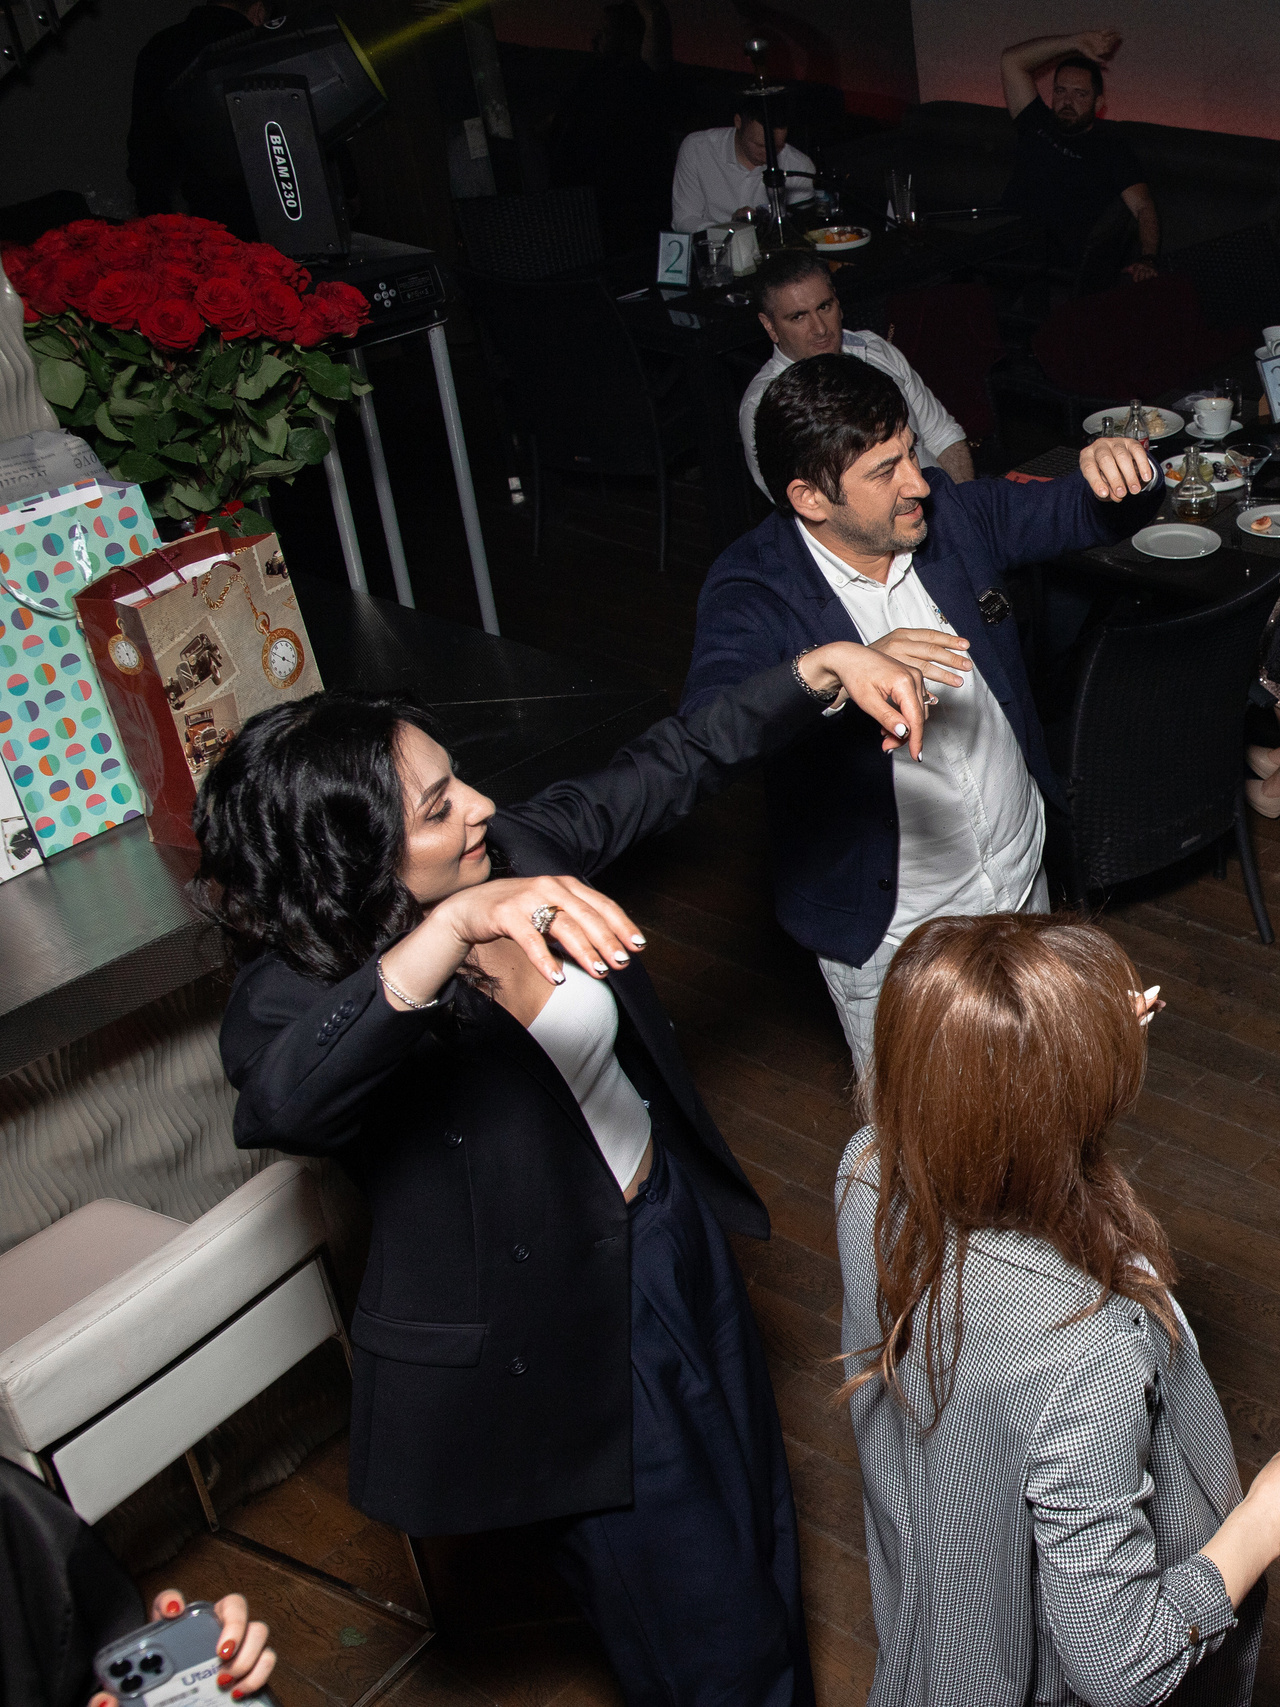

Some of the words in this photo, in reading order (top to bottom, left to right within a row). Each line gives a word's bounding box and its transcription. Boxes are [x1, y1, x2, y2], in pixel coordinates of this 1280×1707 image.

[269, 134, 290, 179] BEAM
[281, 181, 298, 208] 230
[664, 239, 684, 274] 2
